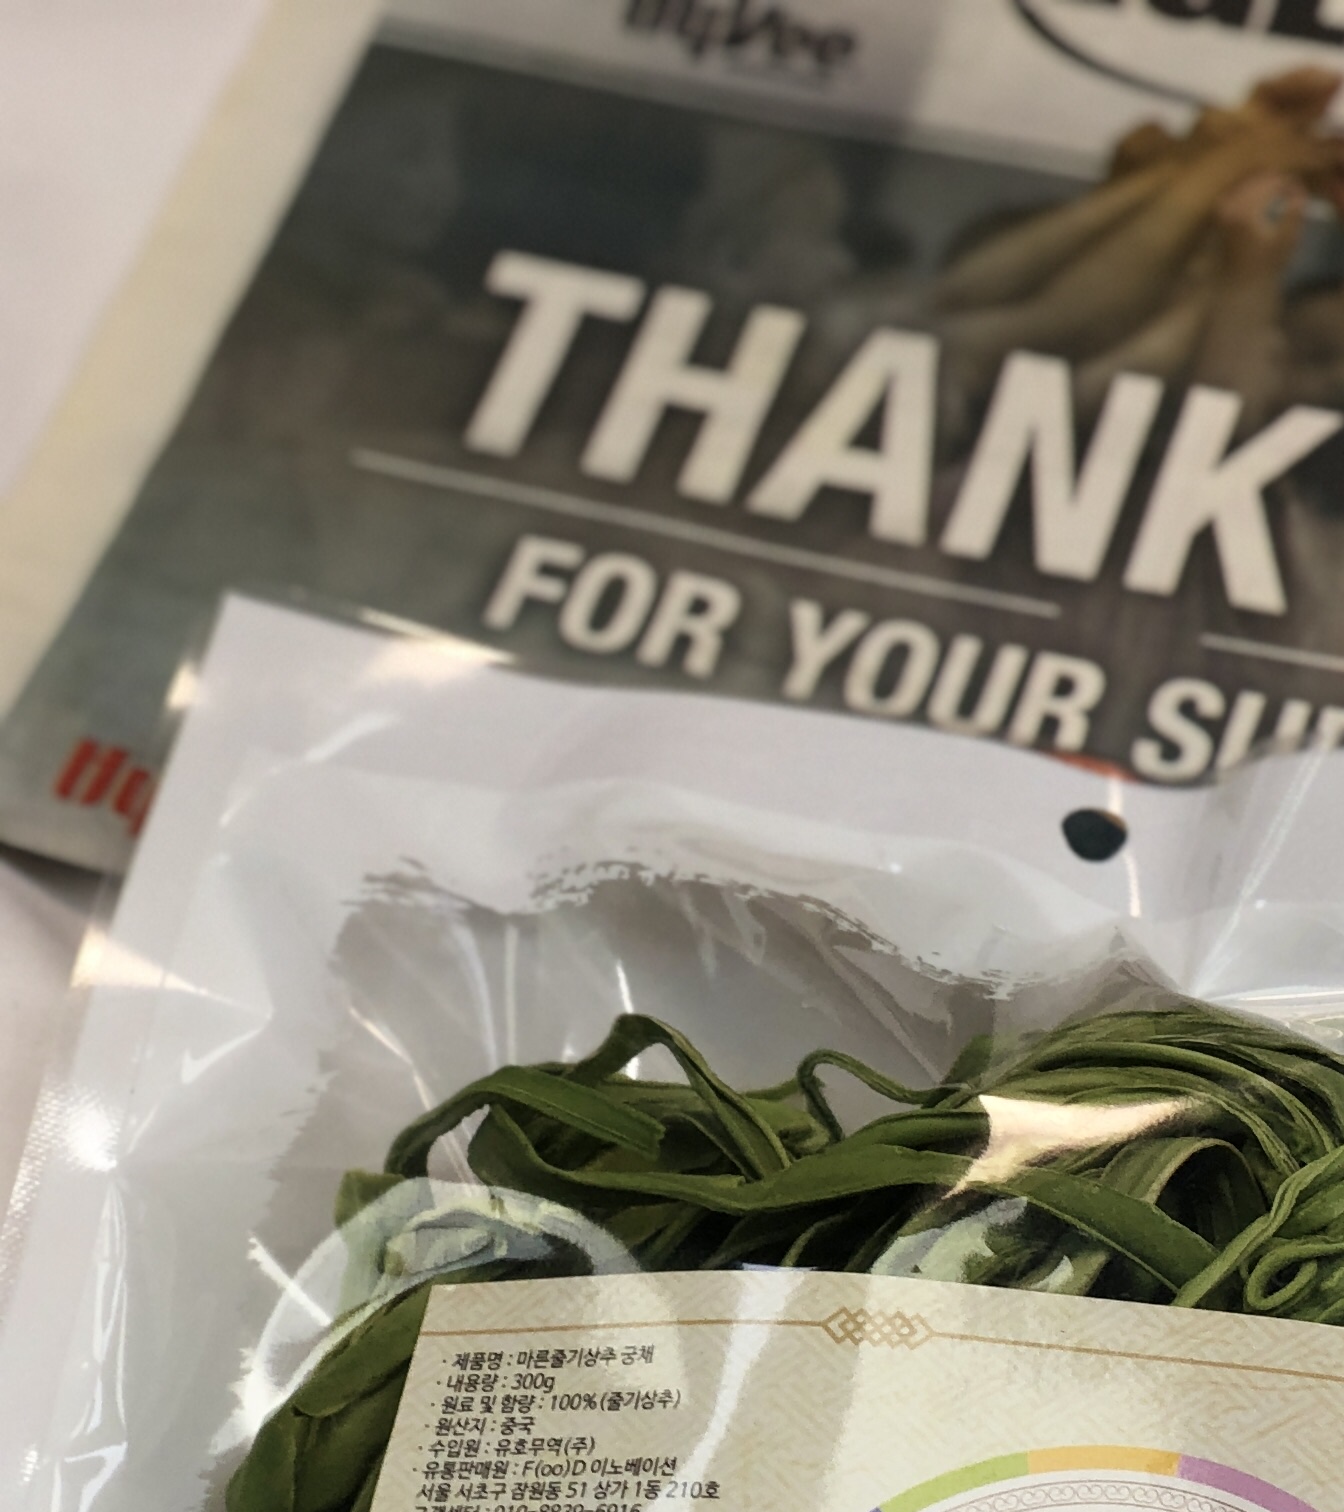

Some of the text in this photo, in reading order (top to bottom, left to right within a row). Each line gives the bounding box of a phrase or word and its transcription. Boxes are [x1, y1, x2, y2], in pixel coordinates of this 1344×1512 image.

[462, 250, 1344, 617] THANK
[483, 535, 741, 678] FOR
[781, 597, 1107, 754] YOUR
[517, 1348, 616, 1369] 마른줄기상추
[621, 1345, 654, 1365] 궁채
[511, 1373, 555, 1393] 300g
[441, 1395, 475, 1414] 원료
[480, 1394, 497, 1413] 및
[500, 1417, 536, 1436] 중국
[591, 1457, 678, 1478] 이노베이션
[416, 1480, 721, 1502] 서울 서초구 잠원동 51 상가 1동 210호
